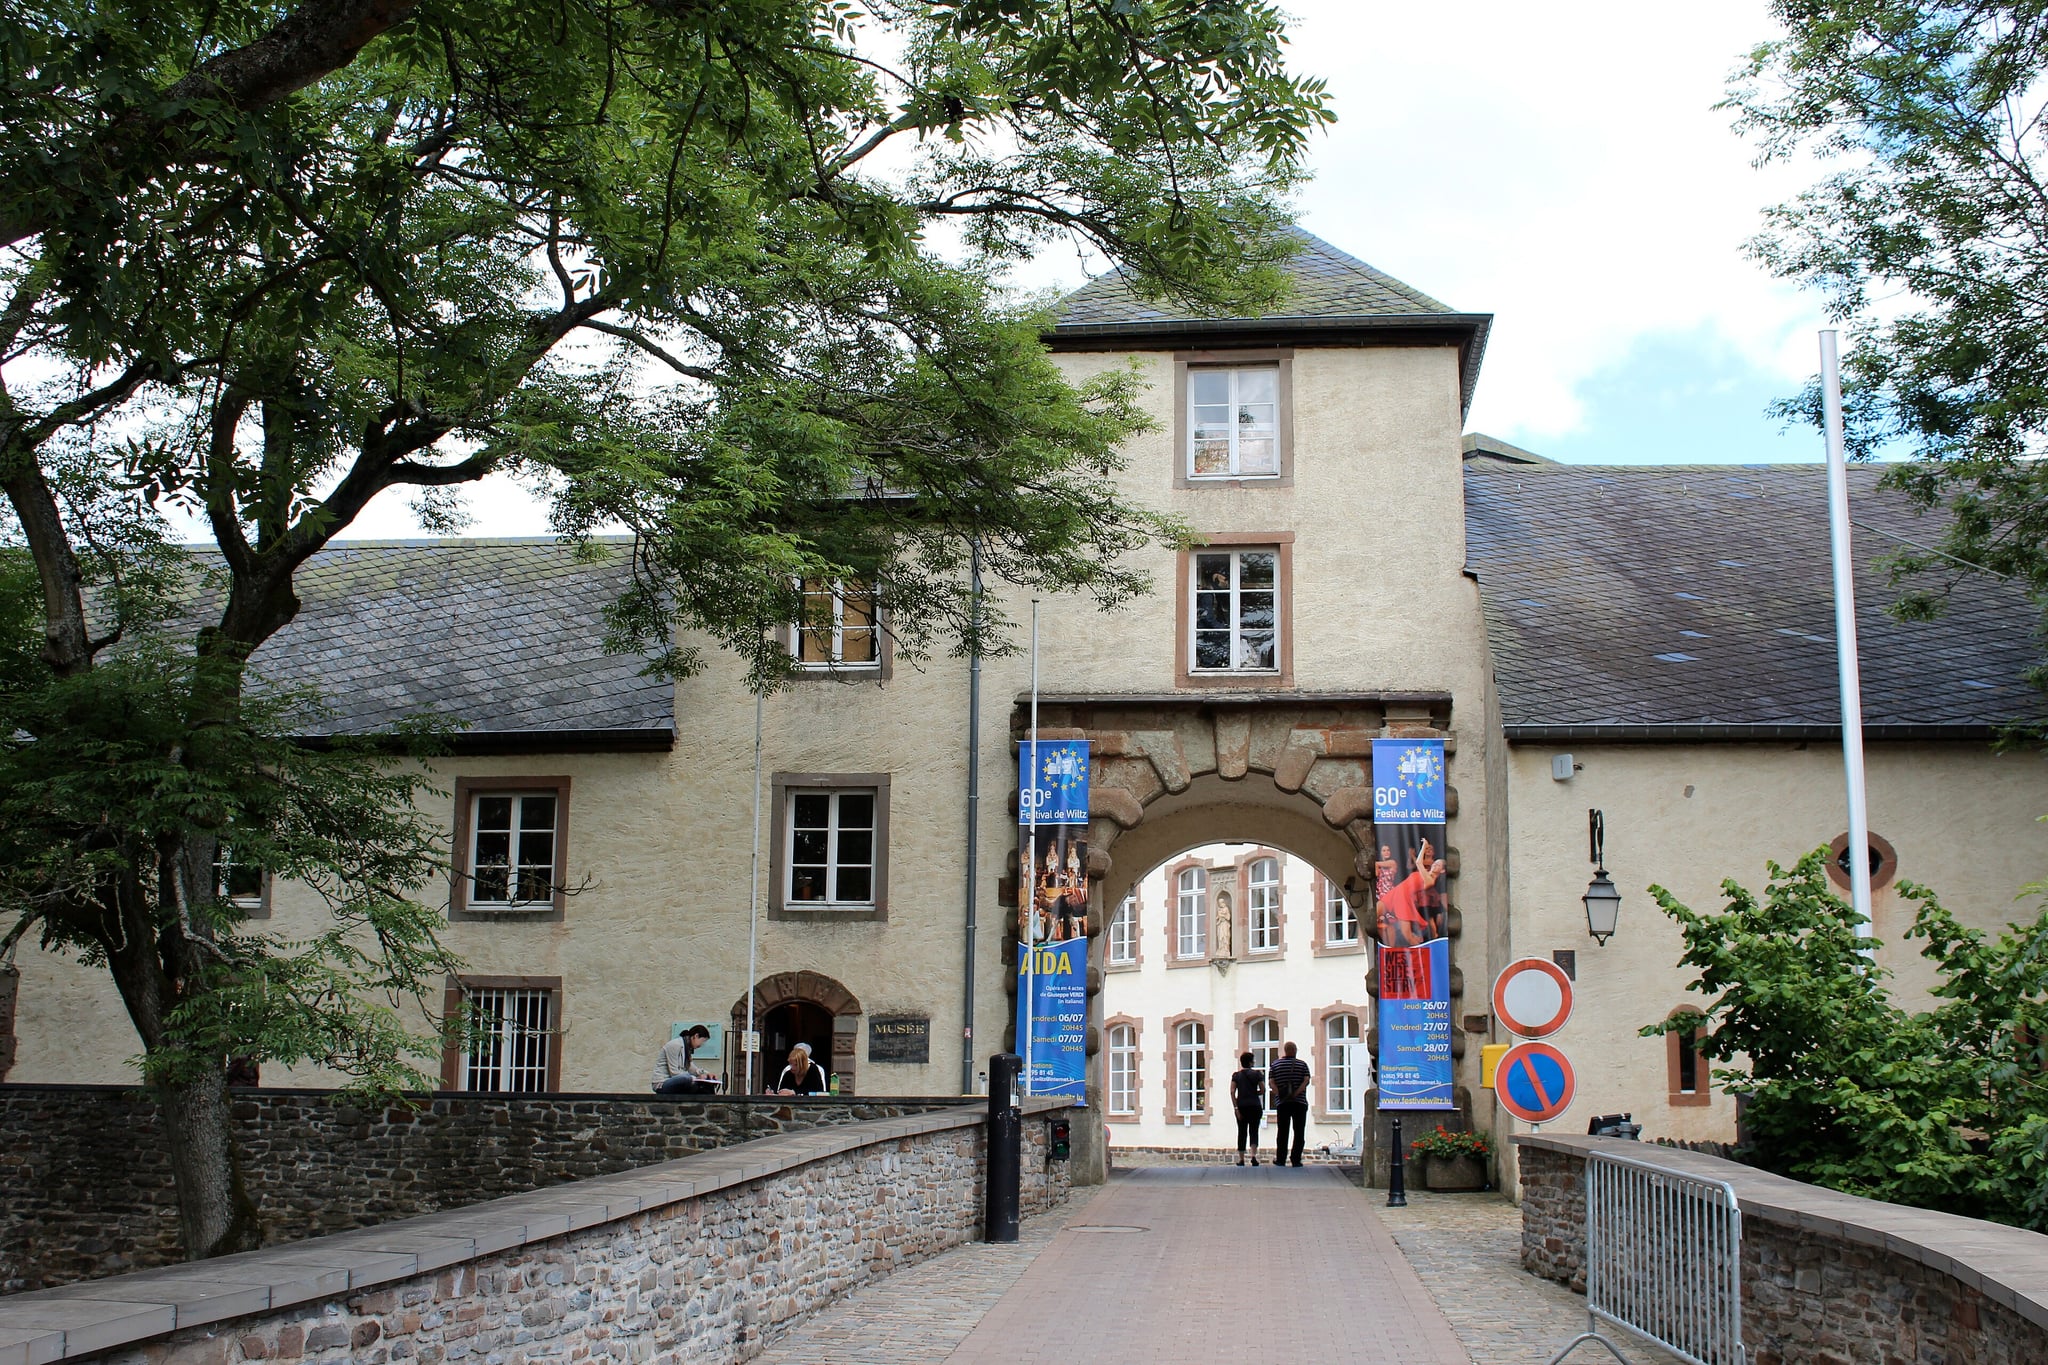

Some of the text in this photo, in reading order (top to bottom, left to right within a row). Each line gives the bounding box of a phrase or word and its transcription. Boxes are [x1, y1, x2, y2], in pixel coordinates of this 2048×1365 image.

[1375, 786, 1407, 807] 60e
[1020, 809, 1087, 820] Fetival de Wiltz
[1375, 808, 1445, 819] Festival de Wiltz
[1020, 947, 1073, 975] AÏDA
[1403, 1001, 1448, 1010] Jeudi 26/07
[1032, 1013, 1084, 1022] endredi 06/07
[875, 1023, 925, 1034] MUSÉE
[1391, 1022, 1449, 1031] Vendredi 27/07
[1033, 1034, 1083, 1043] Samedi 07/07
[1396, 1043, 1449, 1052] Samedi 28/07
[1381, 1096, 1452, 1105] www.festivalwiltz.lu
